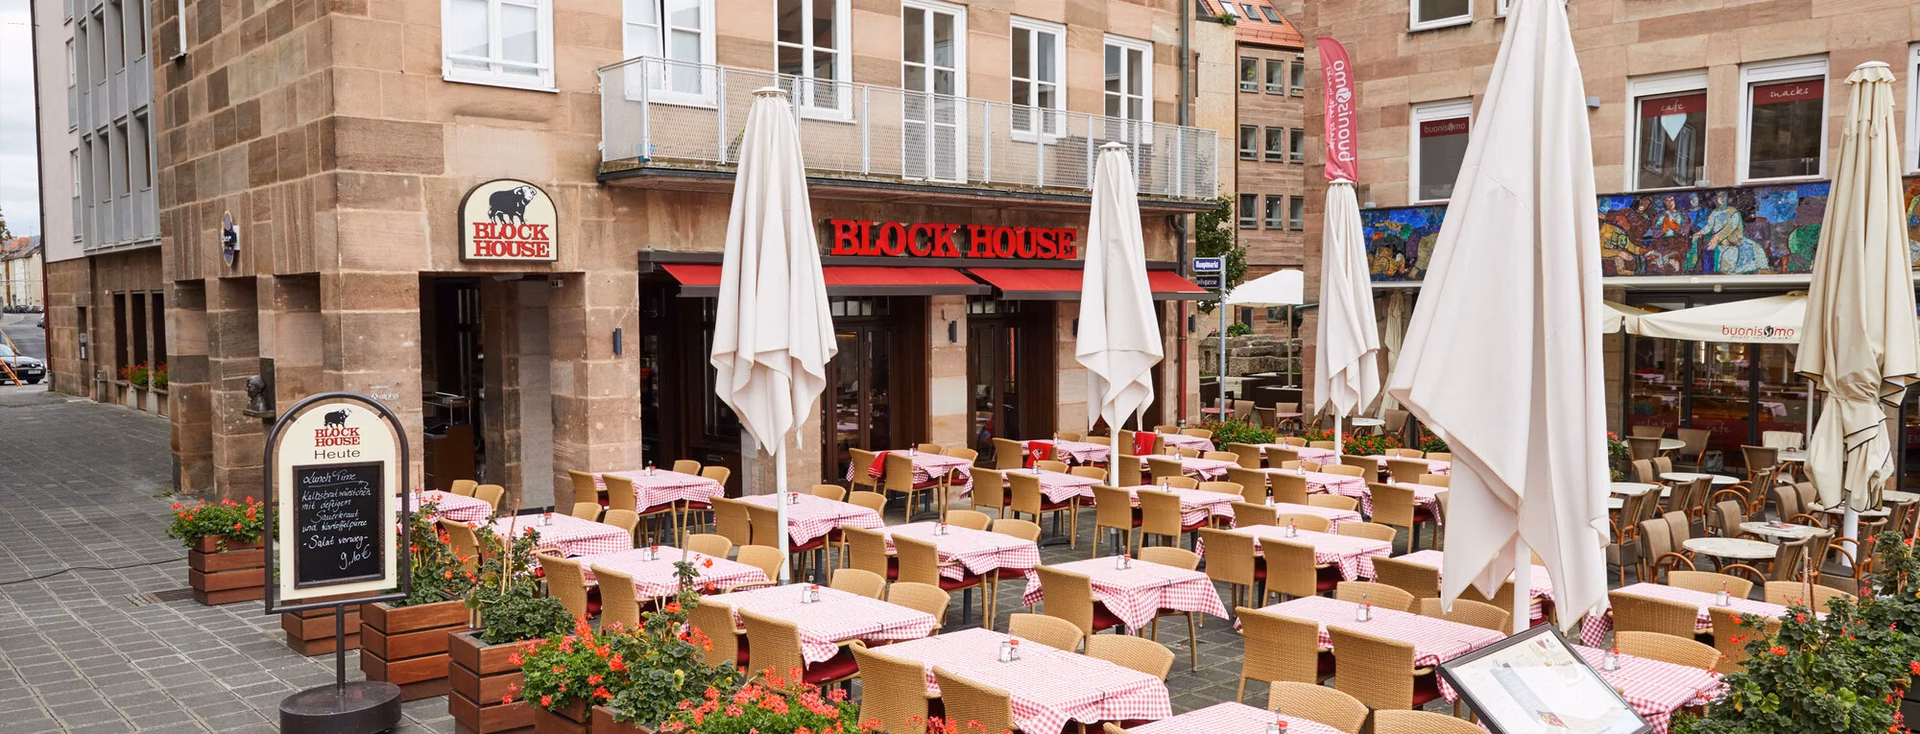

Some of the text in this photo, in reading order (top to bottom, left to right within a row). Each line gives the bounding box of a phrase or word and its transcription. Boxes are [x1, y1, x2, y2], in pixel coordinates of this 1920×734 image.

[1769, 86, 1810, 98] snacks
[472, 222, 550, 241] BLOCK
[830, 218, 1078, 260] BLOCK HOUSE
[473, 240, 550, 258] HOUSE
[314, 427, 360, 438] BLOCK
[314, 436, 361, 447] HOUSE
[314, 449, 361, 459] Heute
[303, 469, 357, 484] Lunch Time
[301, 501, 315, 510] mit
